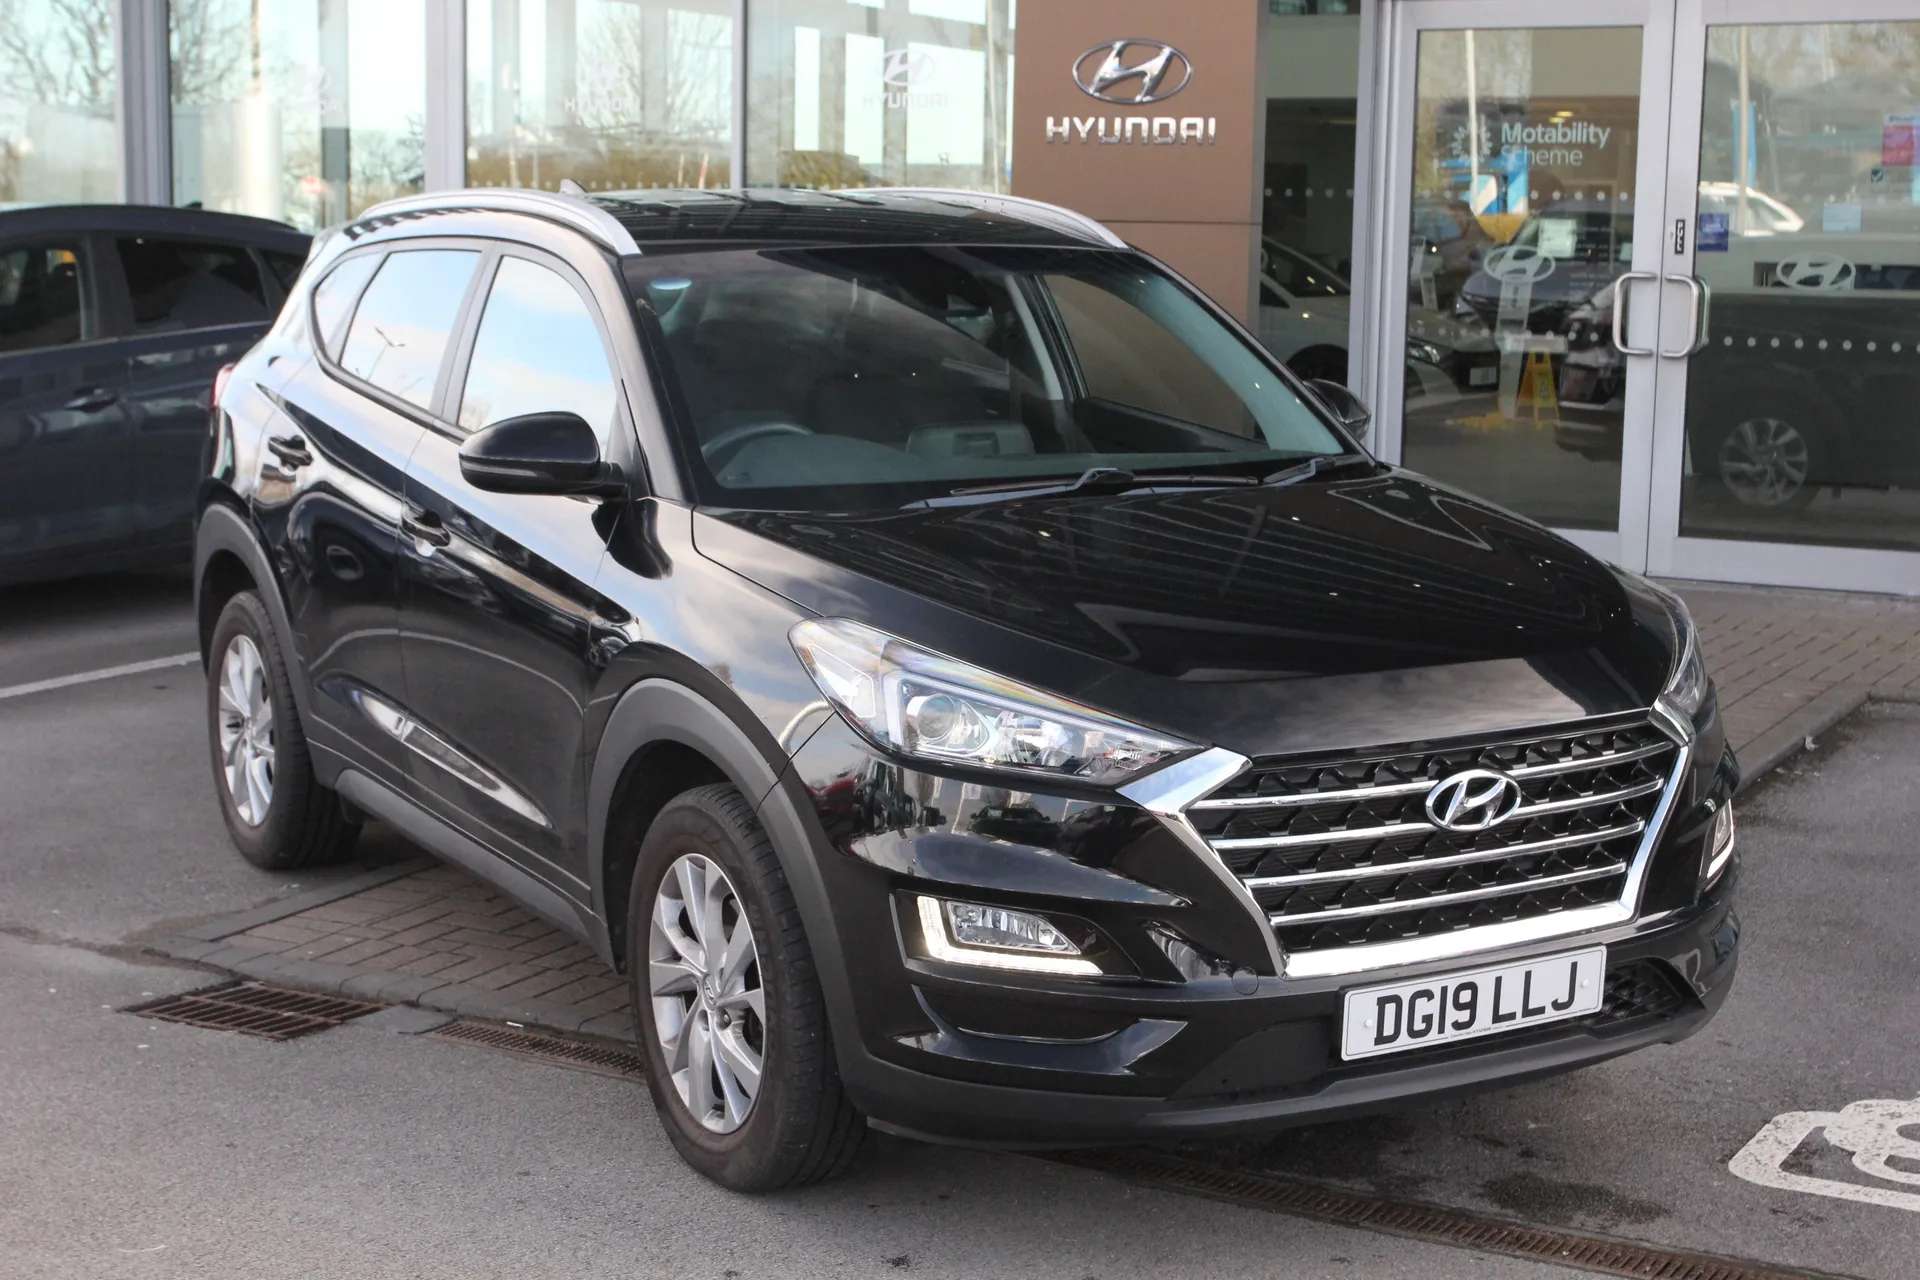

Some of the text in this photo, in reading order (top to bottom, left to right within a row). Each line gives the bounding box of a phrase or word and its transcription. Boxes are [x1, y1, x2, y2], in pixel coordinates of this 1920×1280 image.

[1046, 116, 1216, 144] HYUNDAI
[1501, 121, 1611, 149] Motability
[1374, 961, 1578, 1046] DG19 LLJ
